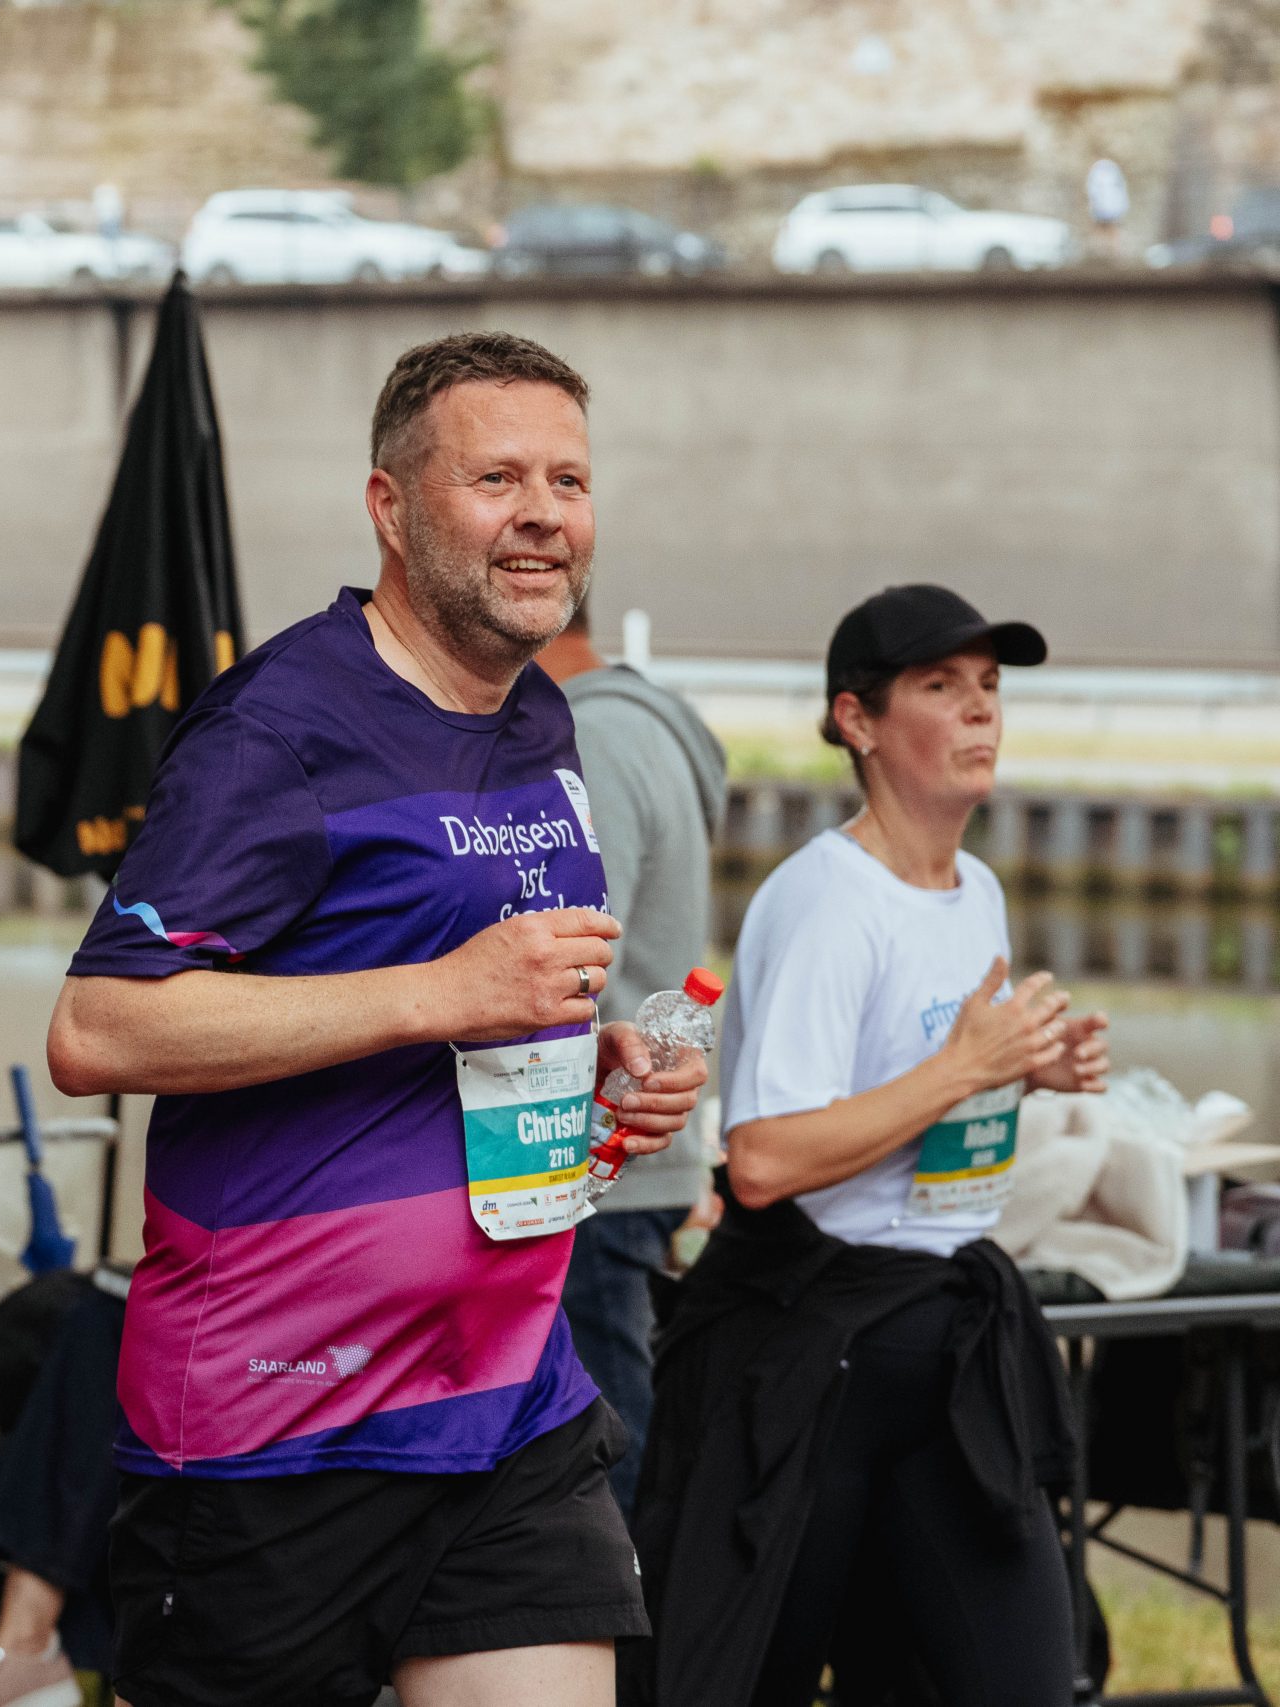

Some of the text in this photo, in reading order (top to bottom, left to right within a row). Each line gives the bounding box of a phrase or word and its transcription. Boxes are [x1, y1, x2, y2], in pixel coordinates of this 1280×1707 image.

[439, 810, 578, 856] Dabeisein
[514, 859, 552, 899] ist
[517, 1101, 587, 1145] Christof
[549, 1146, 575, 1168] 2716
[481, 1200, 497, 1211] dm
[248, 1358, 327, 1375] SAARLAND
